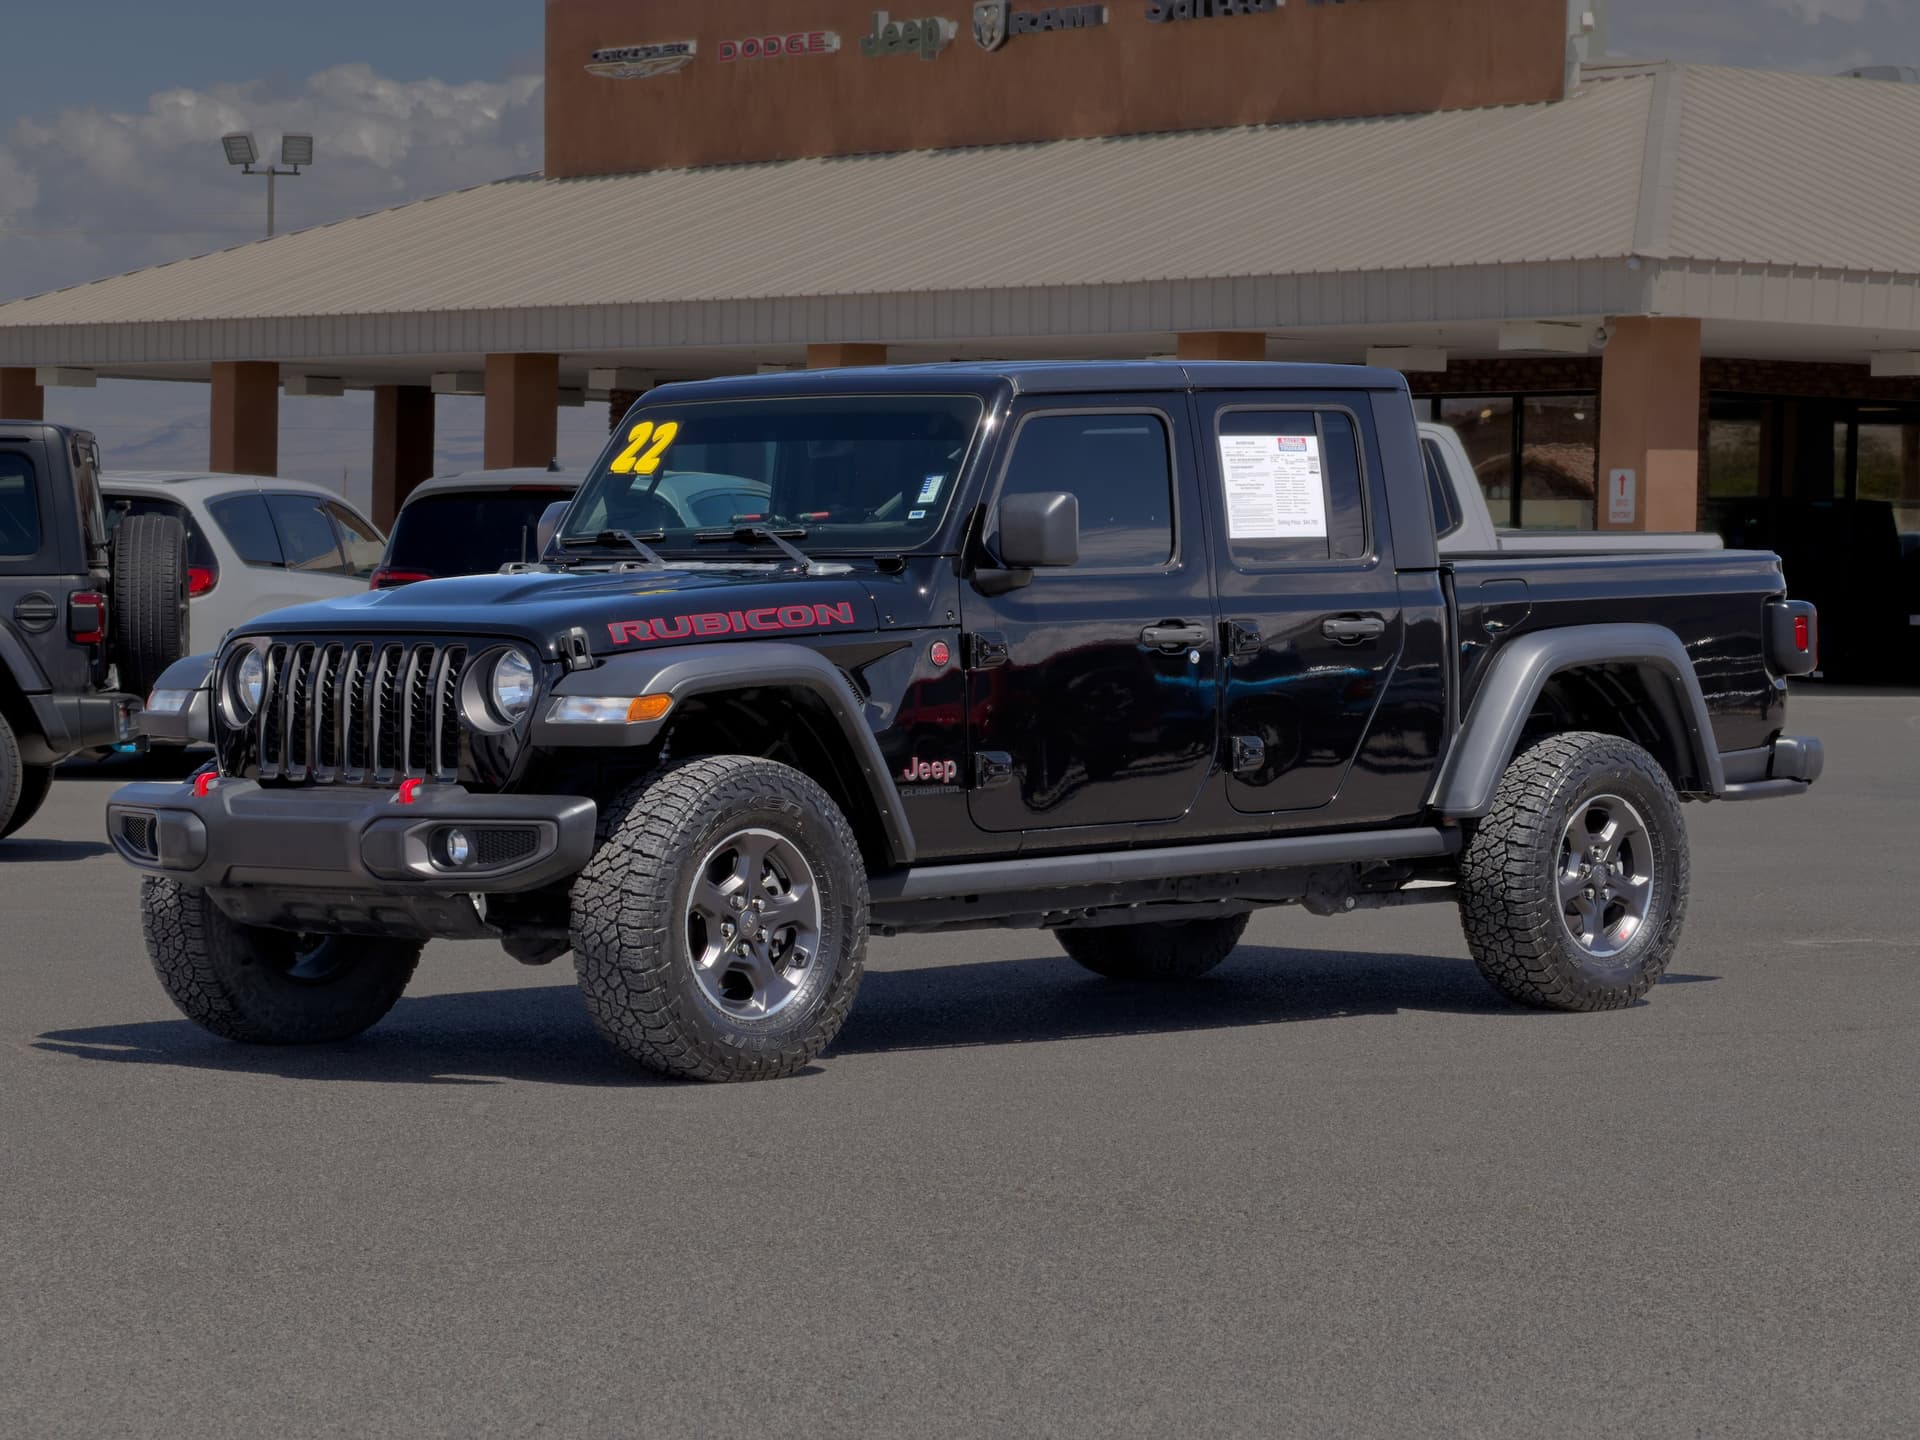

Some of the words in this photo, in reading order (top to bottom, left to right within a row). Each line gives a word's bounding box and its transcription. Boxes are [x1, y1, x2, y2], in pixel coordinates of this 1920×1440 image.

[860, 11, 944, 61] Jeep
[1009, 5, 1104, 35] RAM
[718, 33, 826, 61] DODGE
[610, 421, 680, 475] 22
[608, 602, 855, 644] RUBICON
[903, 756, 957, 784] Jeep
